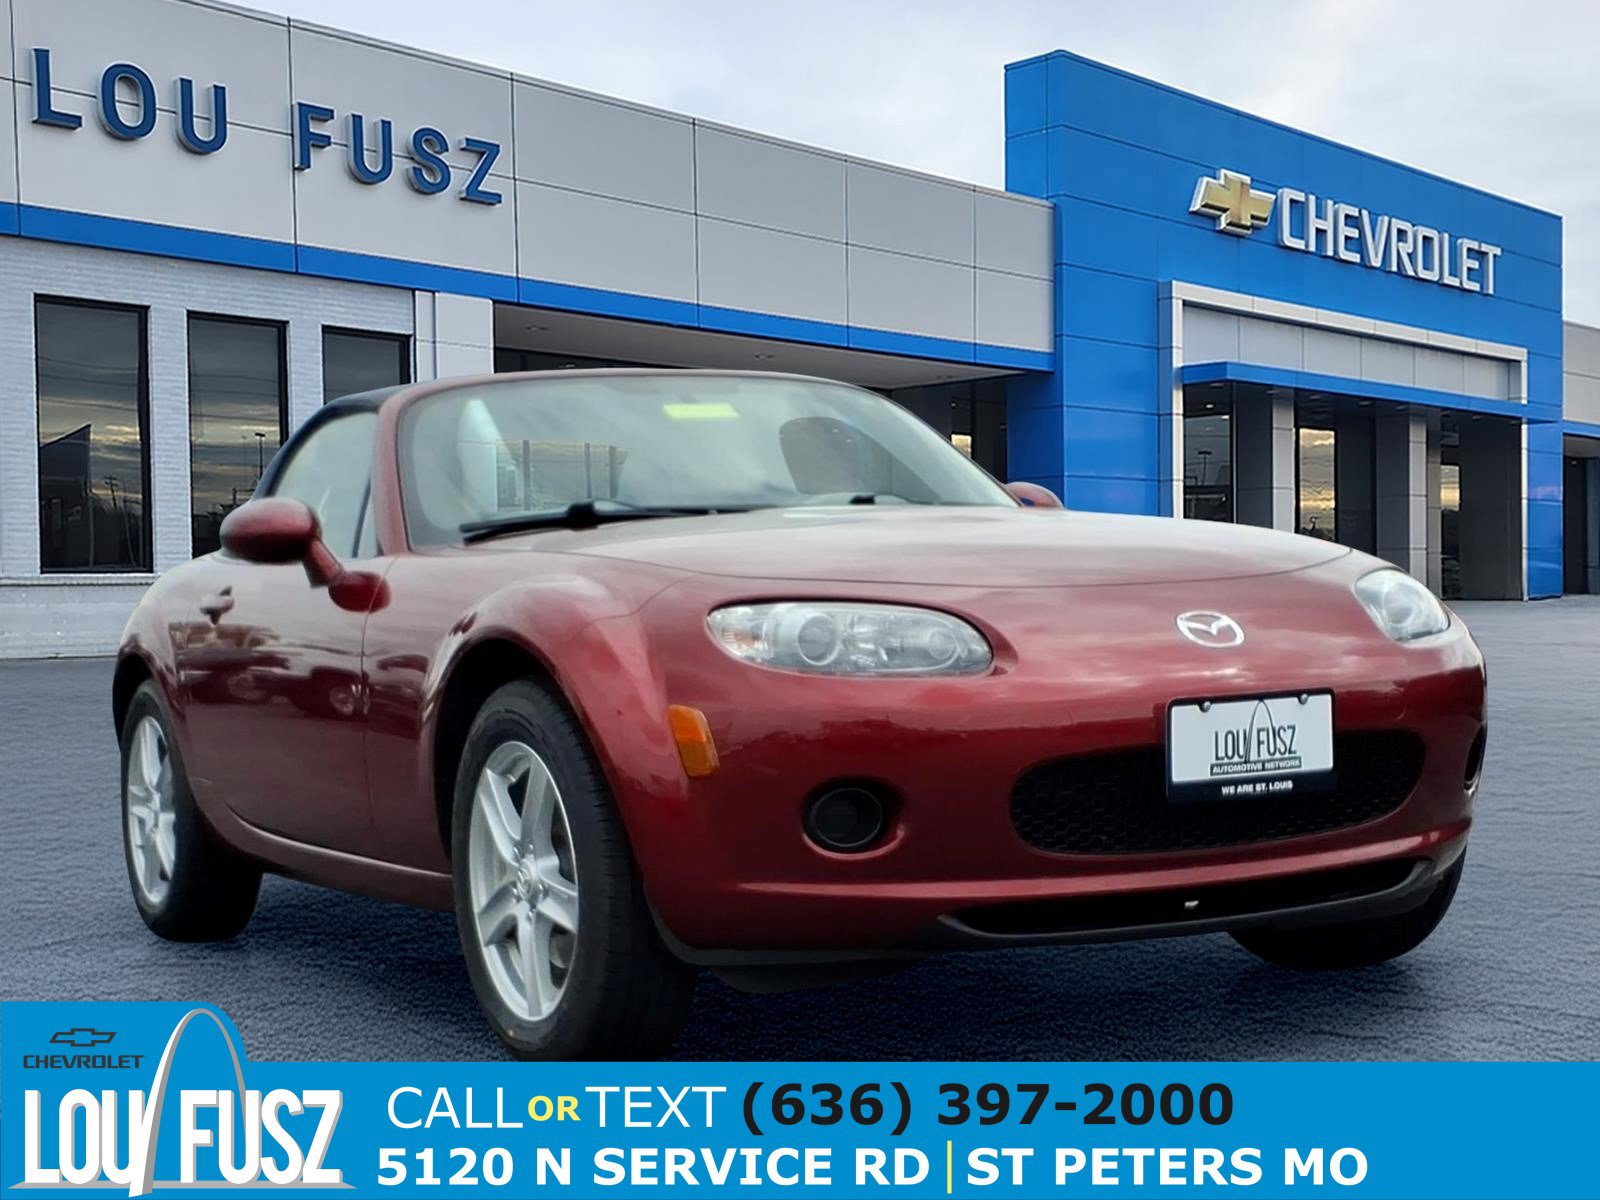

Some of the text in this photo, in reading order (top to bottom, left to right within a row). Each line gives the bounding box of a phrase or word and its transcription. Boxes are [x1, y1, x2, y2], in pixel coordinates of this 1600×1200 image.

[31, 47, 503, 206] LOU FUSZ
[1277, 187, 1502, 295] CHEVROLET
[1214, 725, 1297, 761] LOU FUSZ
[1212, 759, 1301, 774] AUTOMOTIVE NETWORK
[1221, 780, 1293, 795] WE ARE ST. LOUIS
